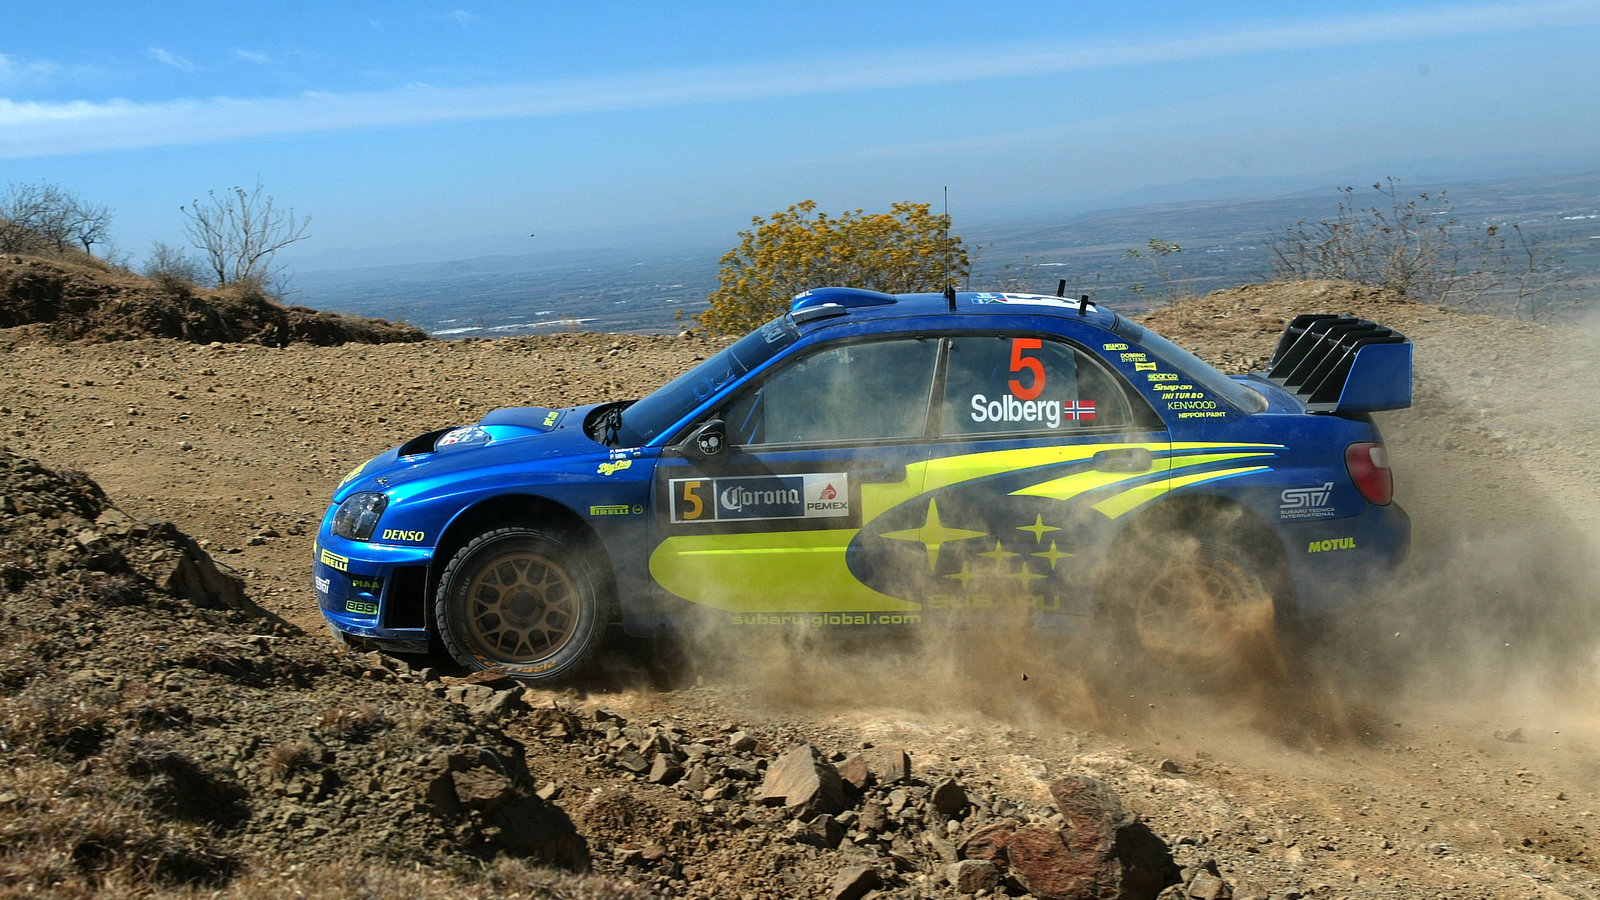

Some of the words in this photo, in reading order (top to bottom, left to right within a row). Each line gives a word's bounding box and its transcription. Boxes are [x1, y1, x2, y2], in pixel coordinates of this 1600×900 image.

[1008, 338, 1046, 401] 5
[971, 394, 1061, 429] Solberg
[1168, 401, 1216, 410] KENWOOD
[683, 481, 704, 520] 5
[720, 485, 801, 512] Corona
[590, 505, 629, 516] PIRELLI
[807, 502, 848, 510] PEMEX
[382, 528, 425, 541] DENSO
[1308, 537, 1356, 552] MOTUL
[321, 548, 349, 572] PIRELLI
[353, 580, 379, 588] PIAA
[347, 601, 377, 614] BBS
